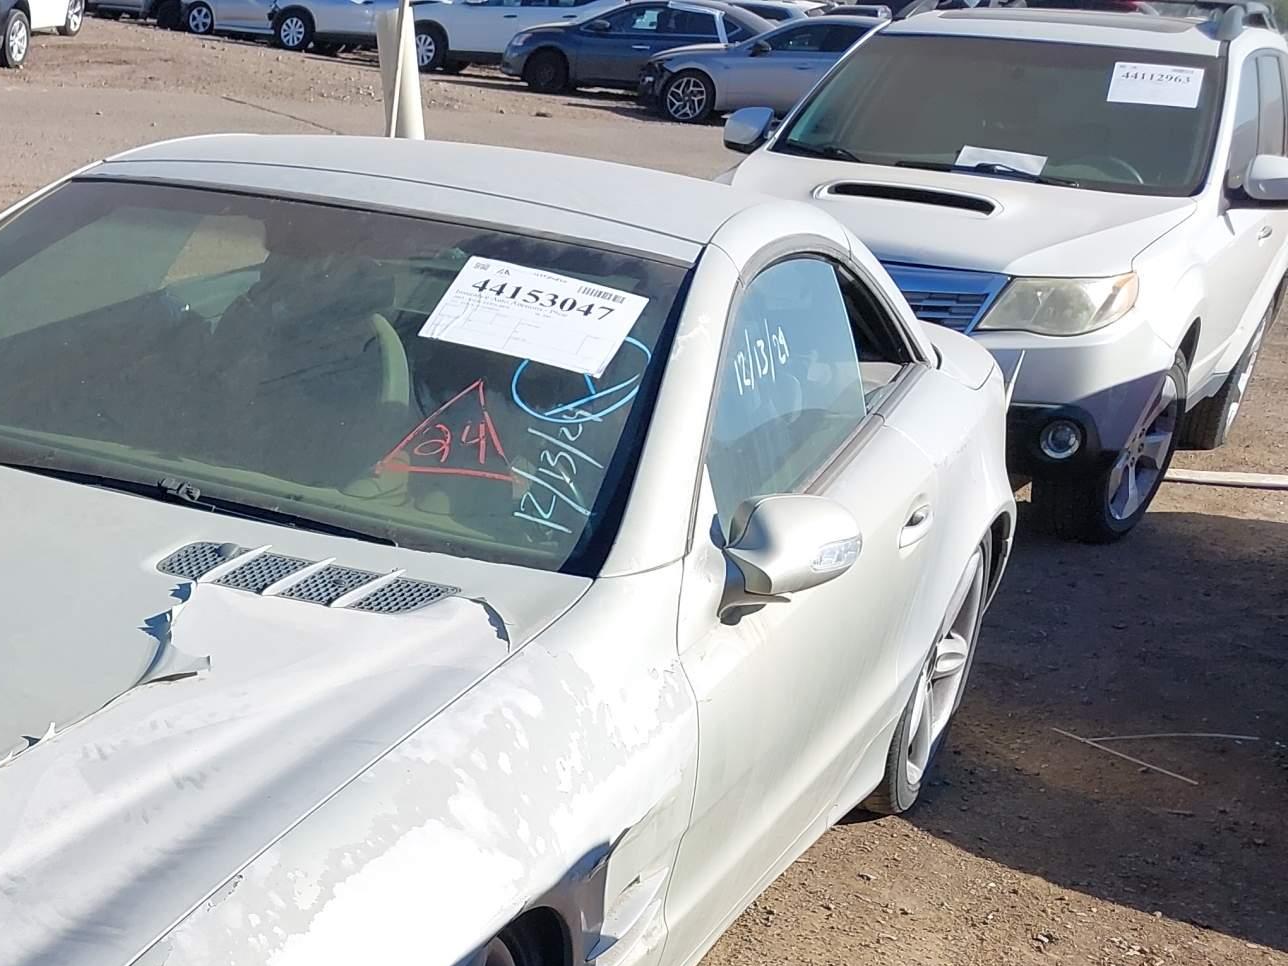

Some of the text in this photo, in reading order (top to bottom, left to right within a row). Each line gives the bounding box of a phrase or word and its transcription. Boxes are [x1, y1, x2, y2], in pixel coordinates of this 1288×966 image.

[1121, 71, 1191, 84] 44112963
[471, 278, 615, 321] 44153047
[414, 421, 486, 464] 24
